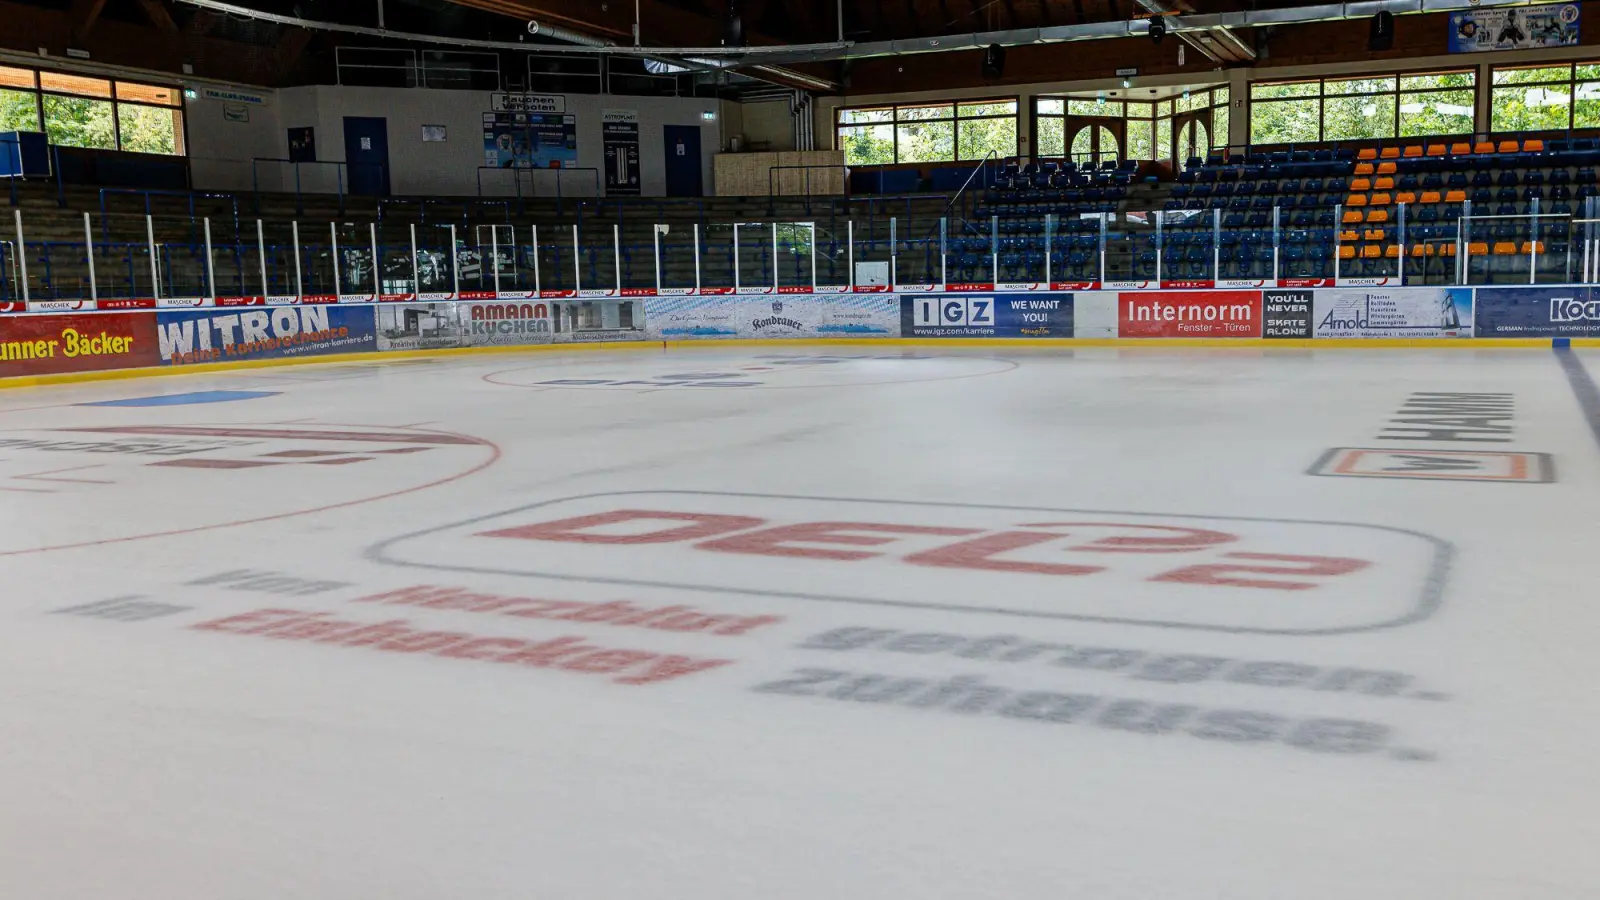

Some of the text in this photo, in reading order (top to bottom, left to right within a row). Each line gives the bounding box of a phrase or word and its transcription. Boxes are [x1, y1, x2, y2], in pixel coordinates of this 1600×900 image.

[502, 96, 555, 104] Rauchen
[1010, 300, 1060, 309] WE WANT
[1268, 294, 1308, 303] YOU'LL
[471, 304, 548, 320] AMANN
[920, 300, 990, 323] IGZ
[1022, 313, 1048, 322] YOU!
[1128, 300, 1252, 321] Internorm
[1318, 304, 1368, 330] Arnold
[158, 306, 330, 360] WITRON
[752, 315, 803, 332] Kondrauer
[914, 326, 994, 336] www.igz.com/karriere
[1178, 323, 1212, 332] Fenster
[1224, 323, 1252, 332] Türen
[1267, 319, 1306, 327] SKATE
[62, 328, 134, 358] Bäcker
[171, 326, 348, 366] Deine Karrierechance
[283, 334, 374, 355] www.witron-karriere.de
[1376, 392, 1514, 442] HAMM
[350, 584, 783, 636] Herzblut
[189, 608, 735, 686] Eishockey
[751, 667, 1440, 762] Zuhause.
